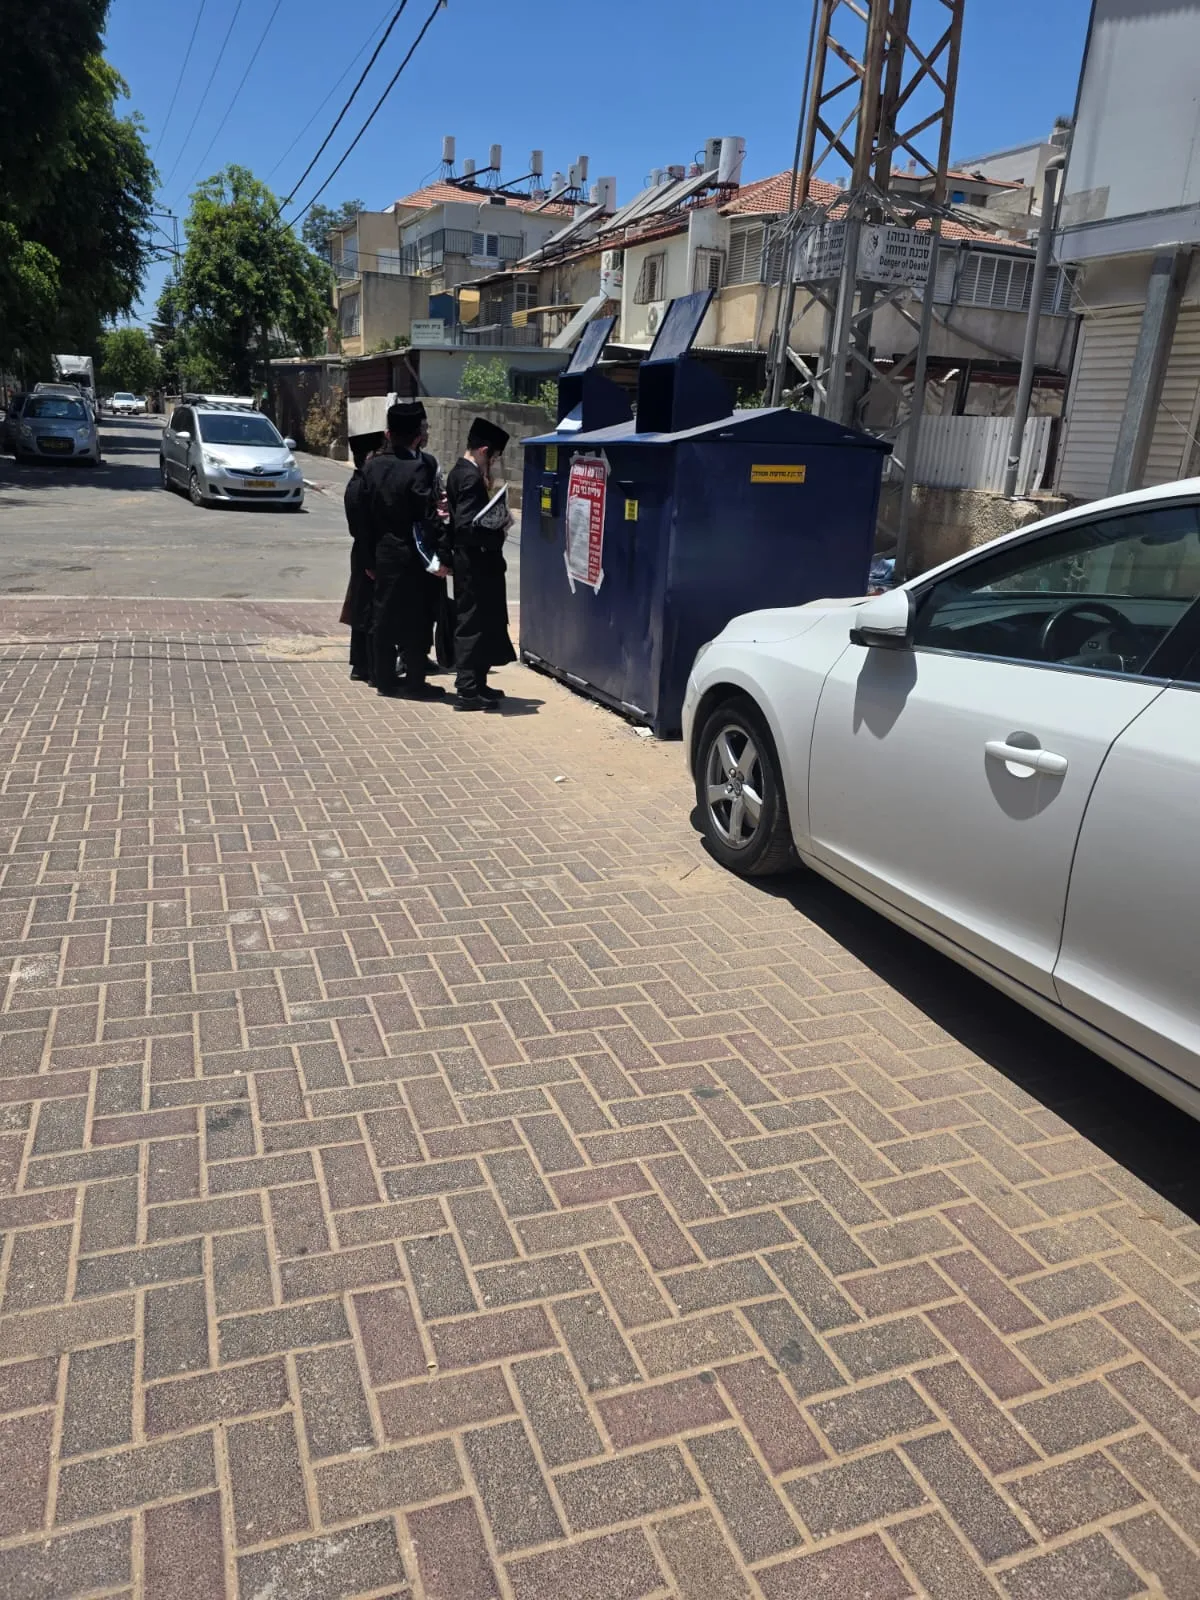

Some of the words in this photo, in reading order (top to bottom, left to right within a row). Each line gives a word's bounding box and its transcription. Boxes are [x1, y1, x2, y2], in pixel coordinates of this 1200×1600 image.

[887, 230, 910, 243] גבוה!
[913, 234, 931, 246] מתח
[885, 244, 906, 256] מוות!
[908, 247, 929, 259] סכנת
[879, 255, 900, 269] Danger
[901, 258, 909, 269] of
[909, 259, 930, 272] Death!
